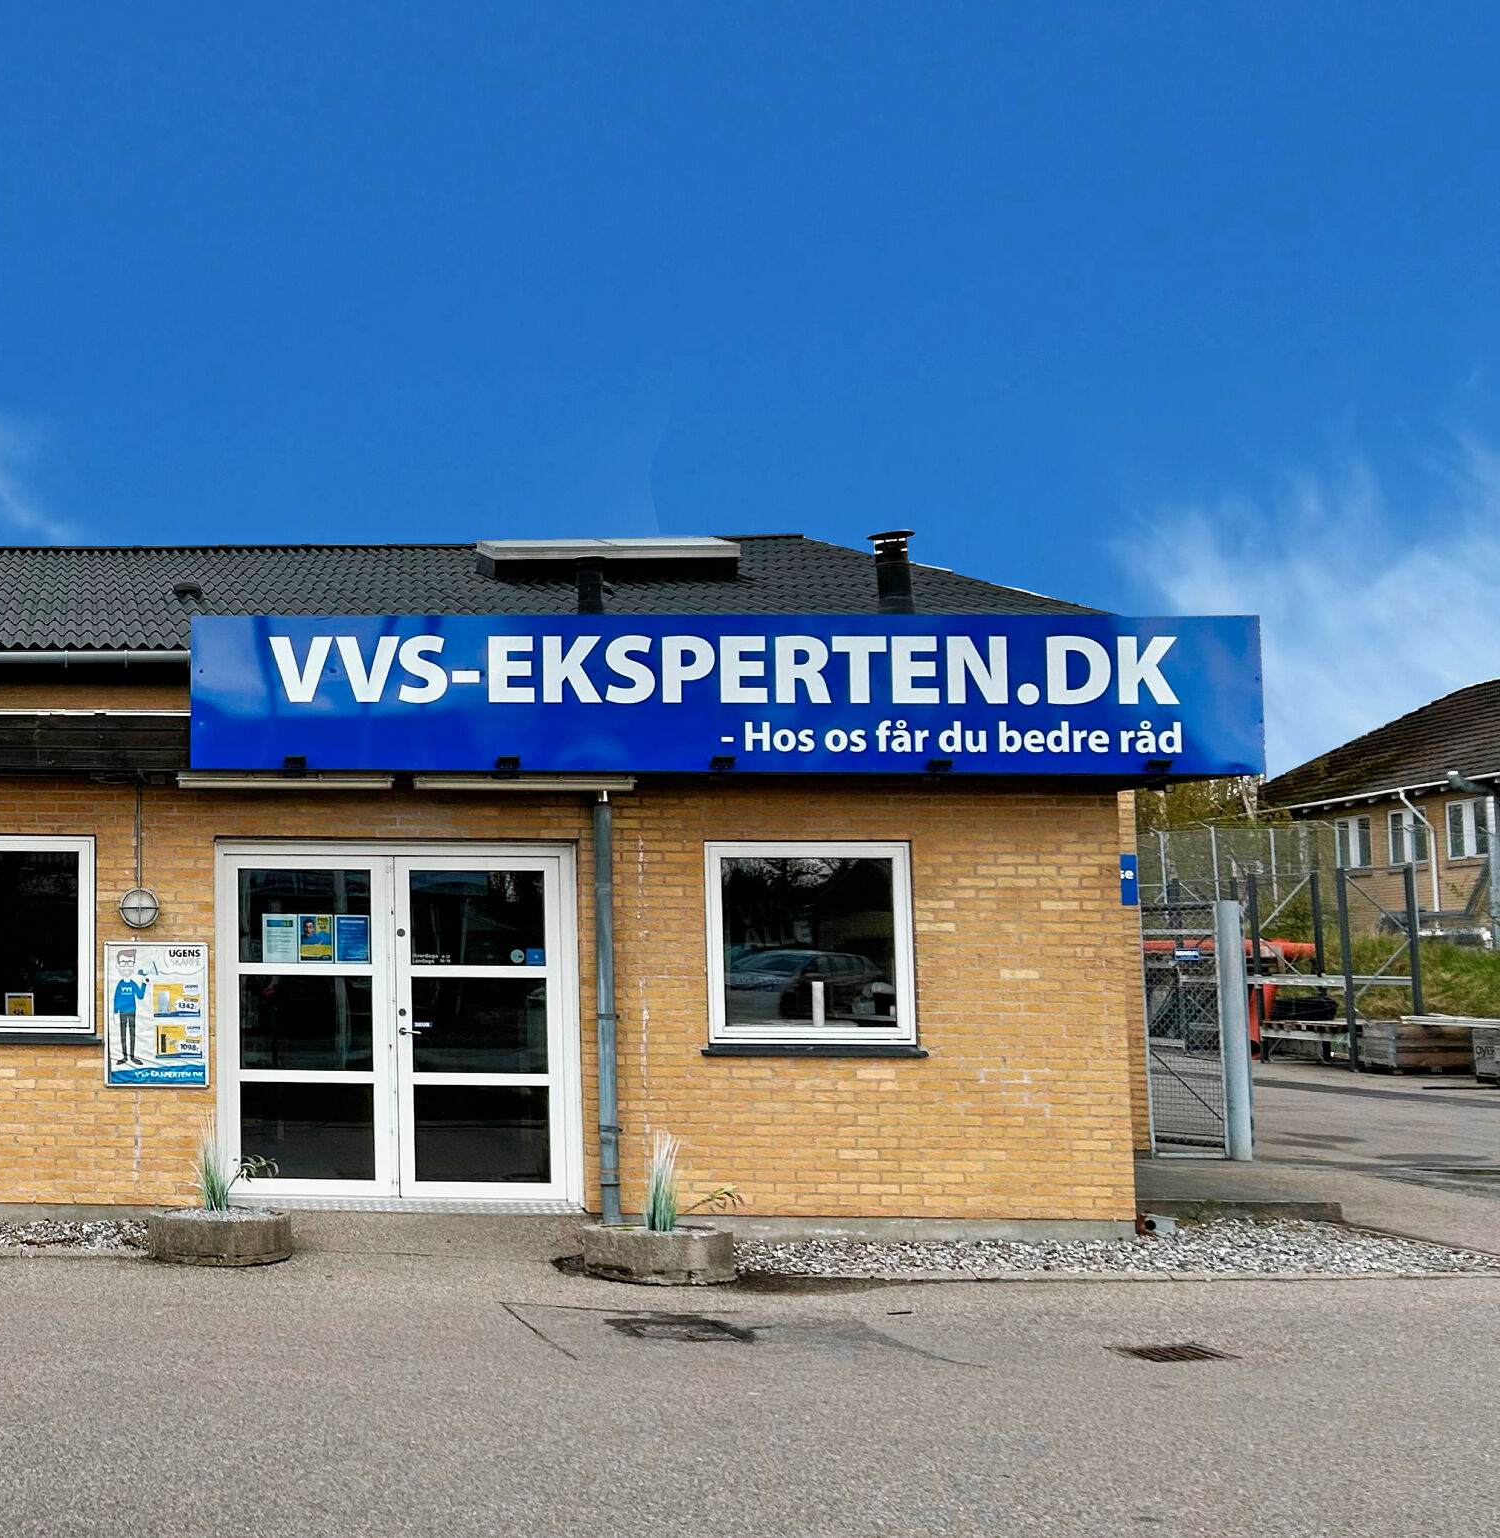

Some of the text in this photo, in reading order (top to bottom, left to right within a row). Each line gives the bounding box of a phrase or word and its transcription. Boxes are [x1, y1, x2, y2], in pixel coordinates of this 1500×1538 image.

[269, 634, 1181, 706] VVS-EKSPERTEN.DK
[745, 721, 815, 752] Hos
[825, 728, 867, 753] os
[876, 719, 929, 753] får
[938, 720, 987, 753] du
[998, 721, 1110, 754] bedre
[1120, 719, 1182, 754] råd
[169, 949, 201, 958] UGENS
[170, 958, 201, 966] SKARPE
